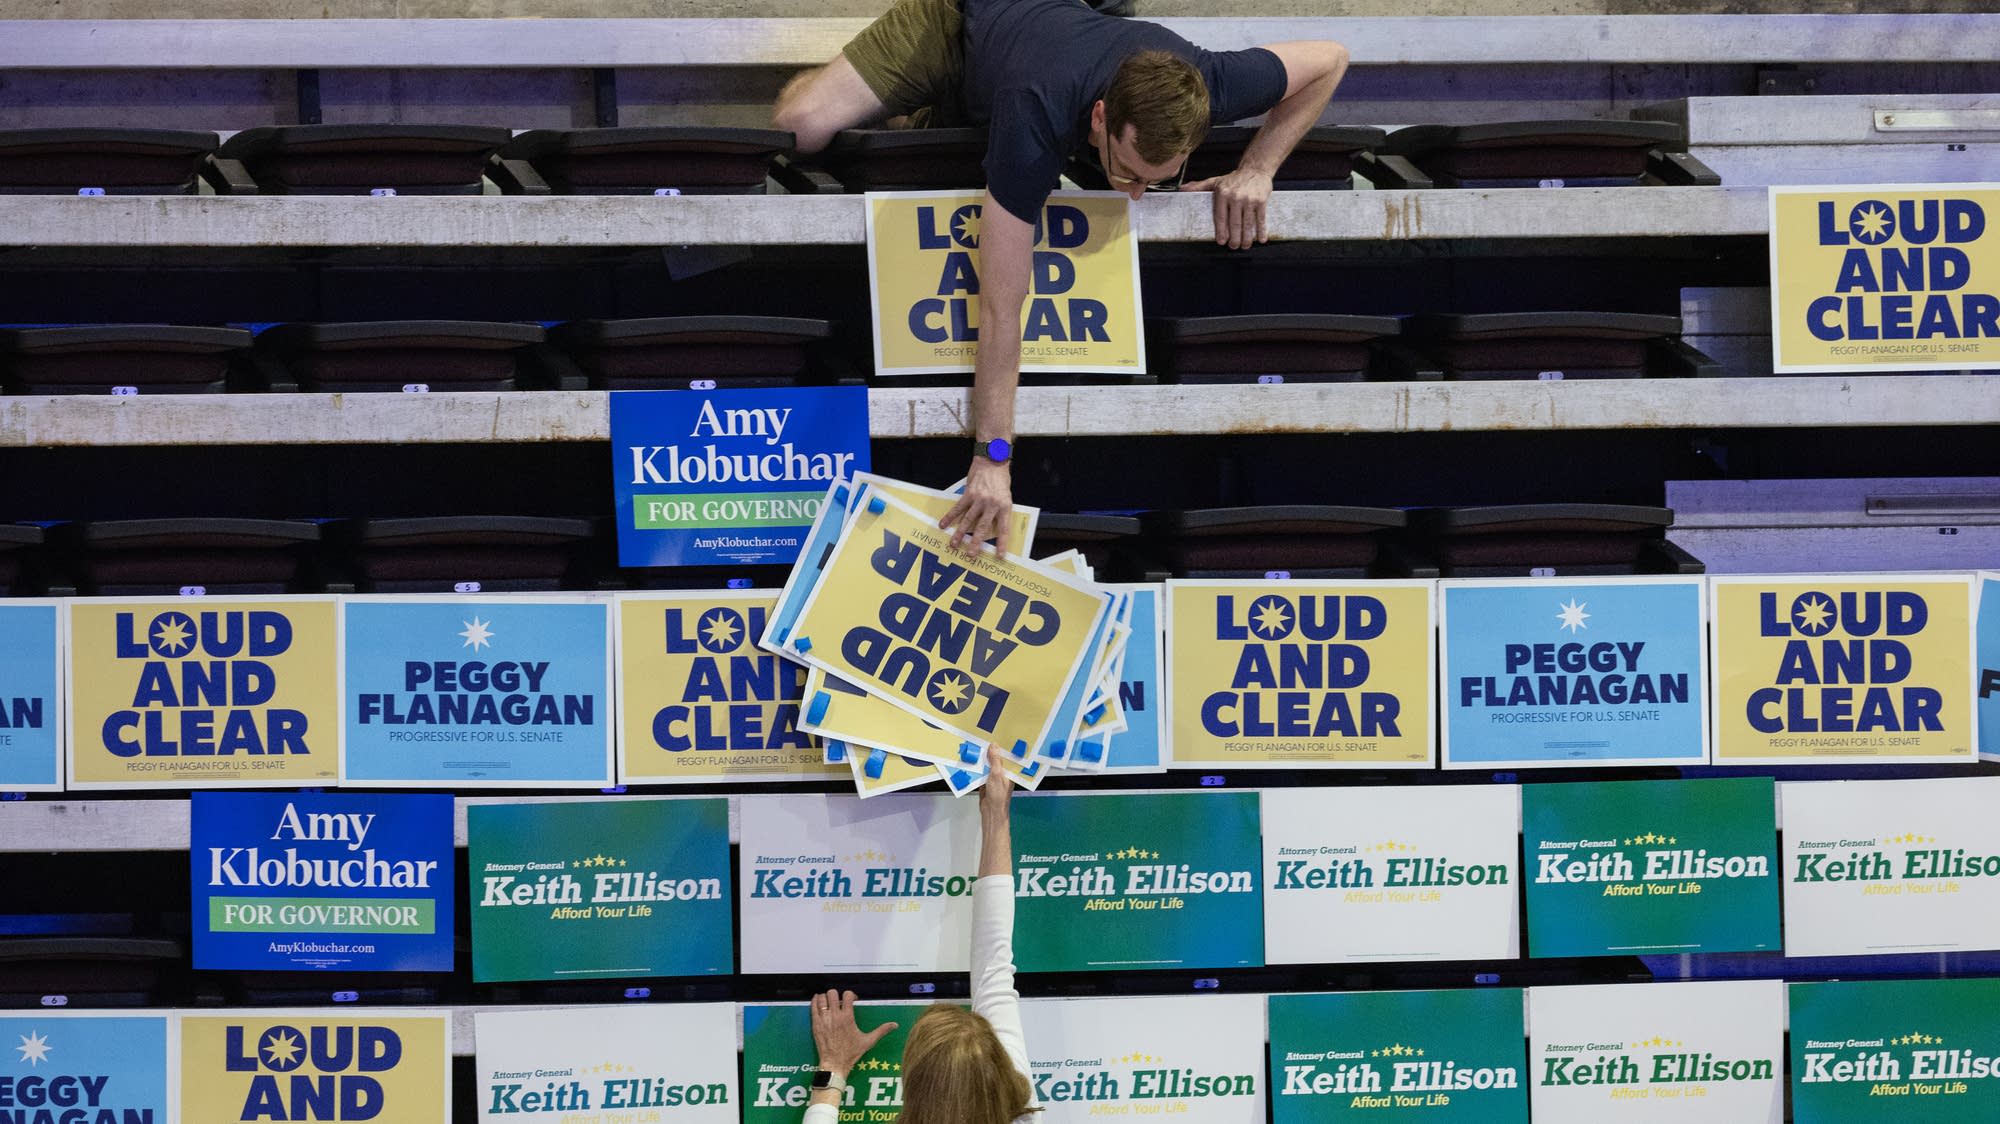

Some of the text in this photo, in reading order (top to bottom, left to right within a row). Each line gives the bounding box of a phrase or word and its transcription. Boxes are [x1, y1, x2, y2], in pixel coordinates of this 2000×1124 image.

[917, 205, 1089, 250] LOD
[1819, 199, 1985, 245] LOUD
[937, 251, 1075, 295] AD
[1835, 247, 1970, 293] AND
[909, 298, 1111, 343] CLAR
[1807, 294, 2000, 341] CLEAR
[934, 348, 964, 356] PEGGY
[1831, 347, 1859, 355] PEGGY
[1861, 346, 1909, 354] FLANAGAN
[1930, 345, 1945, 353] U.S.
[1948, 344, 1979, 352] SENATE
[690, 400, 792, 446] Amy
[630, 443, 854, 484] Klobuchar
[648, 499, 825, 522] FOR GOVERNO
[694, 536, 797, 549] AmyKlobuchar.com
[912, 529, 1051, 597] PEGGY FLANAGAN SENATE
[871, 528, 1061, 646] CLEAR
[1217, 594, 1387, 641] LOUD
[1760, 591, 1928, 637] LOUD
[116, 611, 293, 658] LOUD
[879, 593, 1019, 678] AND
[1231, 644, 1370, 689] AND
[1506, 642, 1645, 674] PEGGY
[1775, 640, 1912, 684] AND
[132, 660, 276, 707] AND
[405, 661, 549, 692] PEGGY
[841, 626, 1010, 734] LOUD
[1461, 673, 1688, 707] FLANAGAN
[359, 694, 593, 725] FLANAGAN
[1201, 691, 1402, 737] CLEAR
[1492, 710, 1659, 724] PROGRESSIVE FOR U.S. SENATE
[1746, 687, 1944, 733] CLEAR
[102, 709, 311, 757] CLEAR
[390, 731, 562, 742] PROGRESSIVE FOR U.S. SENATE
[653, 704, 823, 752] CLEA
[1770, 737, 1920, 747] PEGGY FLANAGAN FOR U.S. SENATE
[677, 756, 797, 766] PEGGY FLANAGAN FOR U.S.
[1225, 743, 1377, 753] PEGGY FLANAGAN FOR U.S. SENATE
[127, 761, 285, 772] PEGGY FLANAGAN FOR U.S. SENATE
[271, 802, 375, 851] Amy
[1020, 853, 1098, 863] Attorney General
[1279, 846, 1356, 856] Attorney General
[1539, 840, 1616, 849] Attorney General
[1798, 839, 1875, 849] Attorney General
[208, 848, 437, 888] Klobuchar
[485, 861, 564, 872] Attorney General
[756, 855, 835, 865] Attorney General
[1274, 857, 1508, 889] Keith Ellison
[1535, 849, 1768, 883] Keith Ellison
[1794, 849, 2000, 882] Keith Elliso
[480, 872, 721, 906] Keith Ellison
[751, 869, 852, 898] Keith
[1016, 864, 1252, 897] Keith Ellison
[1604, 883, 1701, 896] Afford Your Life
[551, 906, 652, 919] Afford Your Life
[1084, 898, 1183, 910] Afford Your Life
[1344, 891, 1440, 903] Afford Your Life
[224, 905, 419, 926] FOR GOVERNOR
[268, 942, 375, 954] AmyKlobuchar.com
[226, 1025, 401, 1072] LOUD
[1286, 1051, 1363, 1061] Attorney General
[1546, 1042, 1623, 1052] Attorney General
[1805, 1039, 1883, 1049] Attorney General
[492, 1069, 572, 1080] Attorney General
[759, 1064, 799, 1073] Attorney
[1065, 1058, 1102, 1066] General
[1541, 1053, 1773, 1086] Keith Ellison
[1802, 1052, 1900, 1083] Keith
[0, 1076, 109, 1107] EGGY
[1129, 1069, 1255, 1099] Ellison
[1281, 1061, 1517, 1095] Keith Ellison
[1870, 1082, 1967, 1095] Afford Your Life
[240, 1075, 384, 1121] AND
[488, 1082, 590, 1114] Keith
[601, 1078, 728, 1109] Ellison
[1351, 1094, 1449, 1108] Afford Your Life
[868, 1110, 898, 1121] Your
